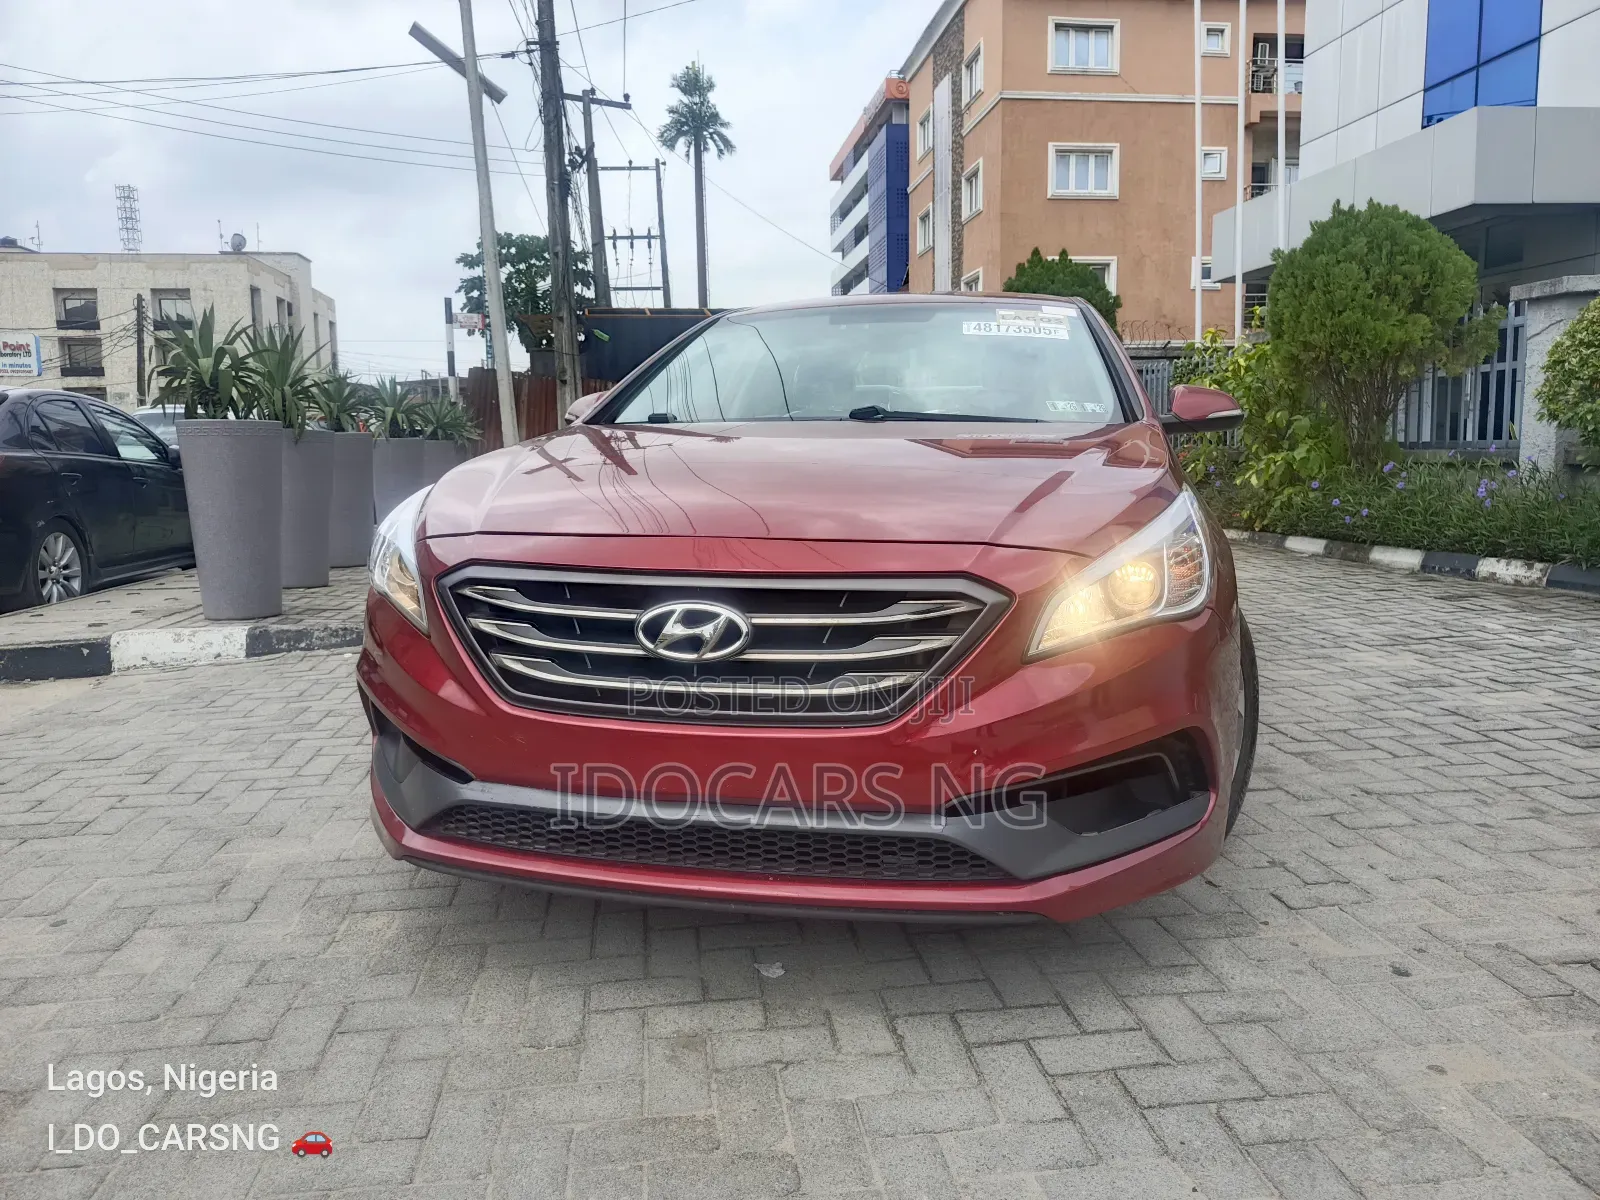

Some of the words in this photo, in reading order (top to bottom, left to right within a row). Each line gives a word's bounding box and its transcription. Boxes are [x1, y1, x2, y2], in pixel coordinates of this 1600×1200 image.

[1001, 314, 1064, 325] LAGOS
[2, 341, 31, 352] Point
[22, 350, 32, 358] LTD
[8, 361, 32, 369] minutes
